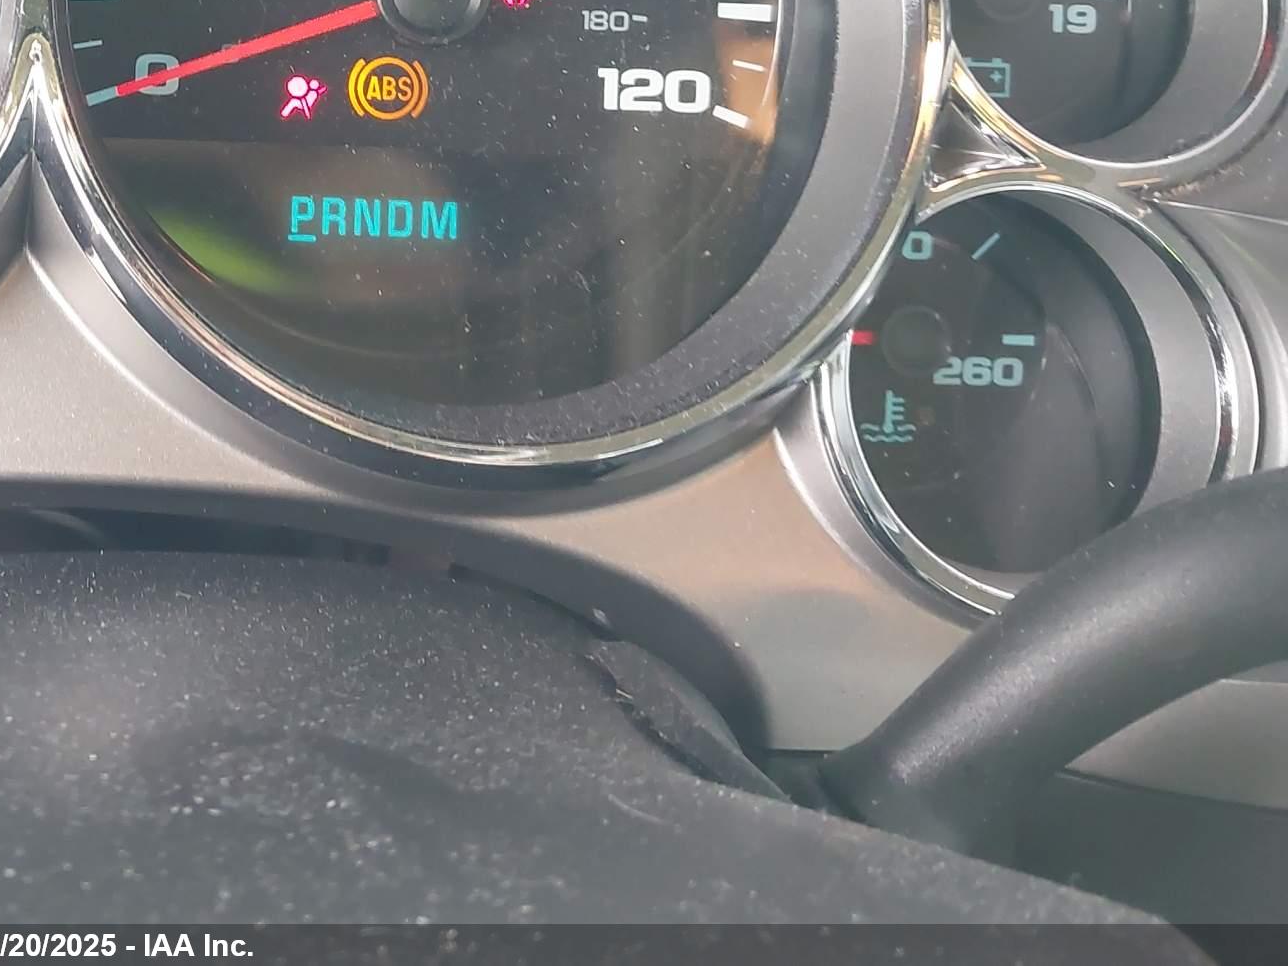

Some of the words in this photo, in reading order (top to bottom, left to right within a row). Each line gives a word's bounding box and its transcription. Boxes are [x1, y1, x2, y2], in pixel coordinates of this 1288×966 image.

[582, 9, 629, 32] 180
[1048, 4, 1098, 34] 19
[135, 53, 180, 96] 0
[367, 75, 412, 103] ABS
[598, 67, 712, 113] 120
[932, 357, 1024, 386] 260
